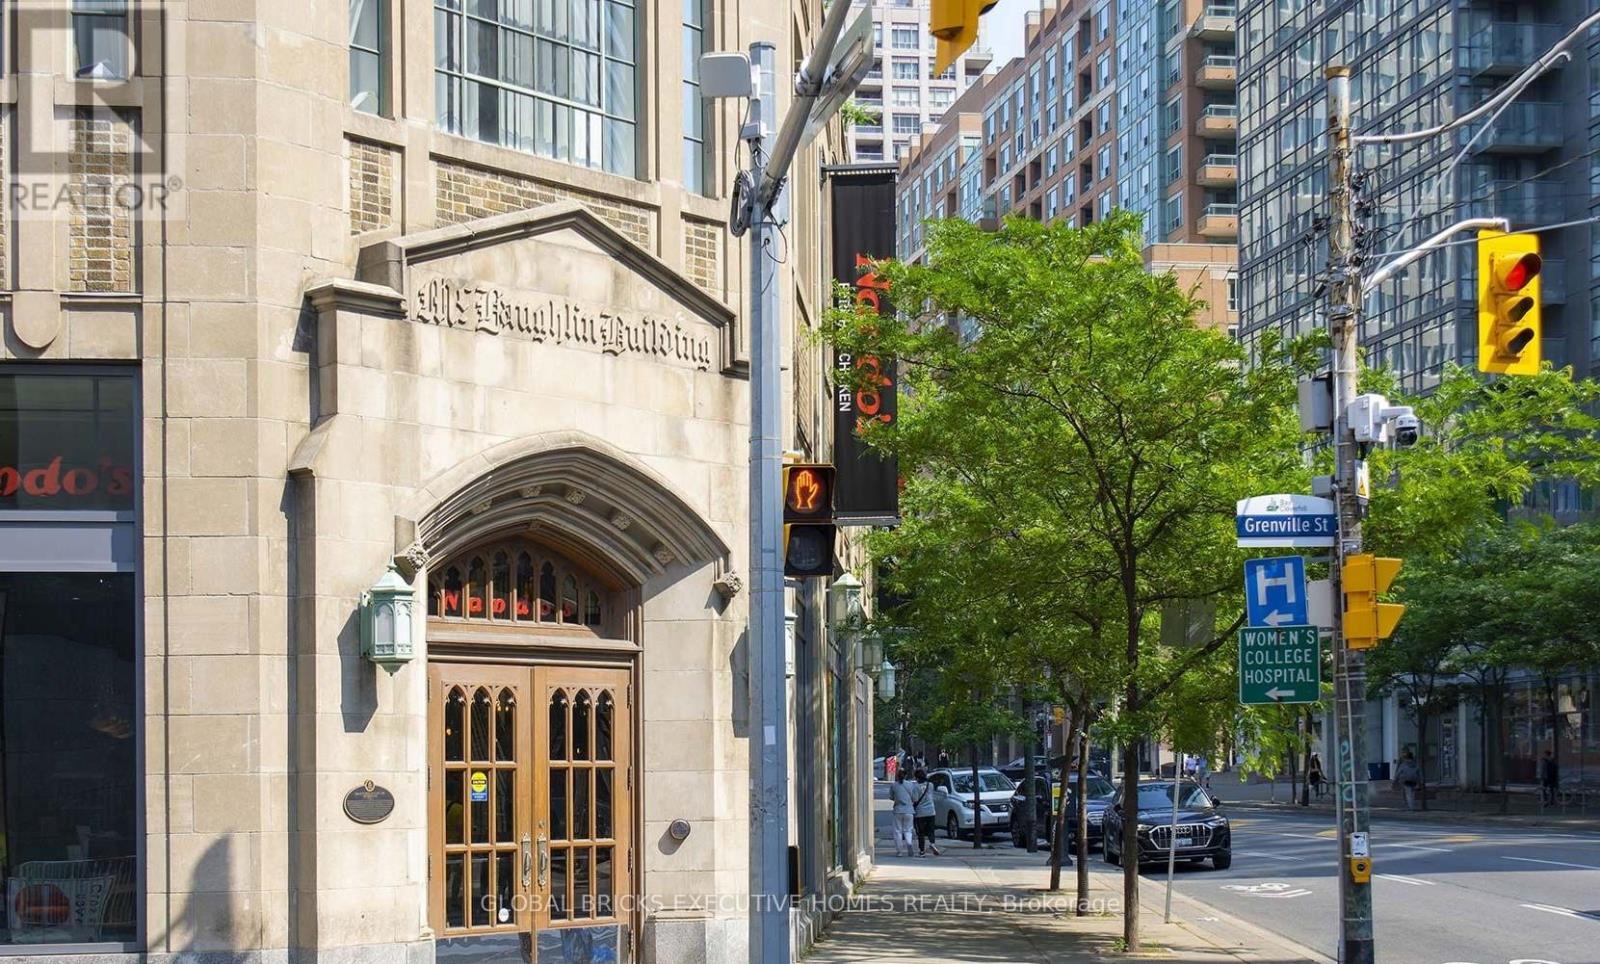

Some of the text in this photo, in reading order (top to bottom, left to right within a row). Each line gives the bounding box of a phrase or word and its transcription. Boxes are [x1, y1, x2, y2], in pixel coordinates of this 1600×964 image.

[600, 311, 711, 372] Building
[1245, 517, 1328, 533] Grenville St
[1256, 562, 1296, 606] H
[1245, 629, 1315, 647] WOMEN'S
[1245, 648, 1313, 665] COLLEGE
[1245, 668, 1315, 684] HOSPITAL
